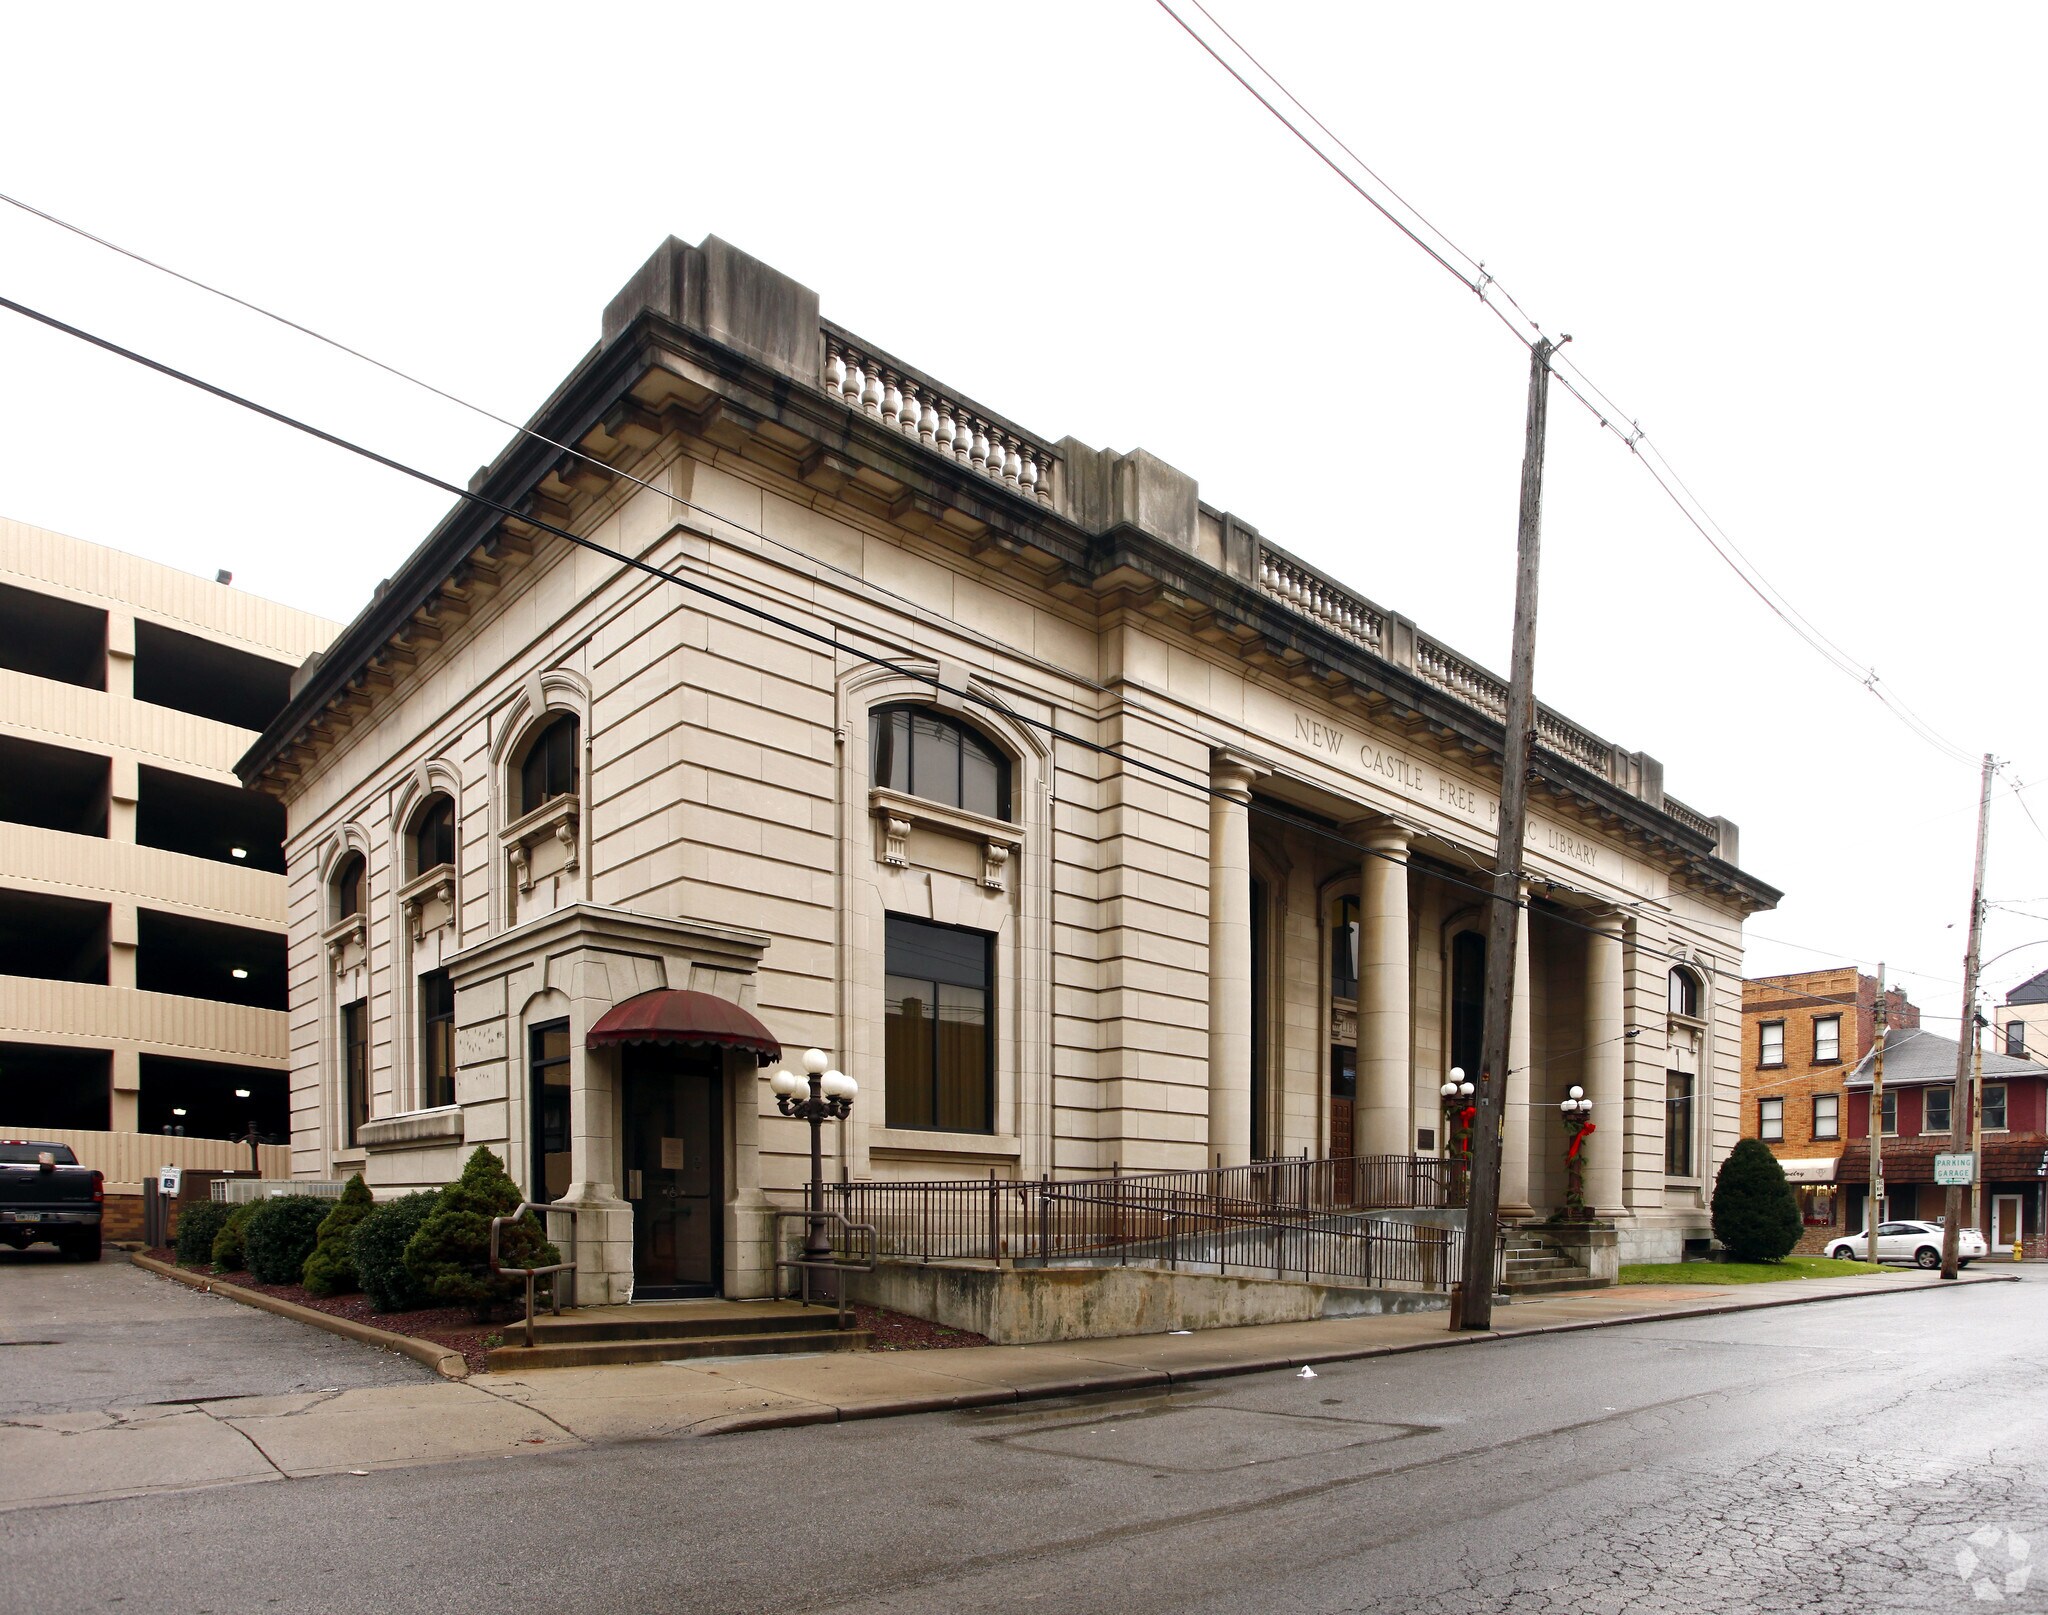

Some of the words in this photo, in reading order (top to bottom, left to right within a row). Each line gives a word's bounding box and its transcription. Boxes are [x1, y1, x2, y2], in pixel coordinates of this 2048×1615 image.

[1294, 713, 1344, 755] NEW
[1360, 744, 1423, 791] CASTLE
[1438, 778, 1476, 814] FREE
[1548, 828, 1598, 867] LIBRARY
[1936, 1159, 1971, 1167] PARKING
[1937, 1169, 1969, 1177] GARAGE
